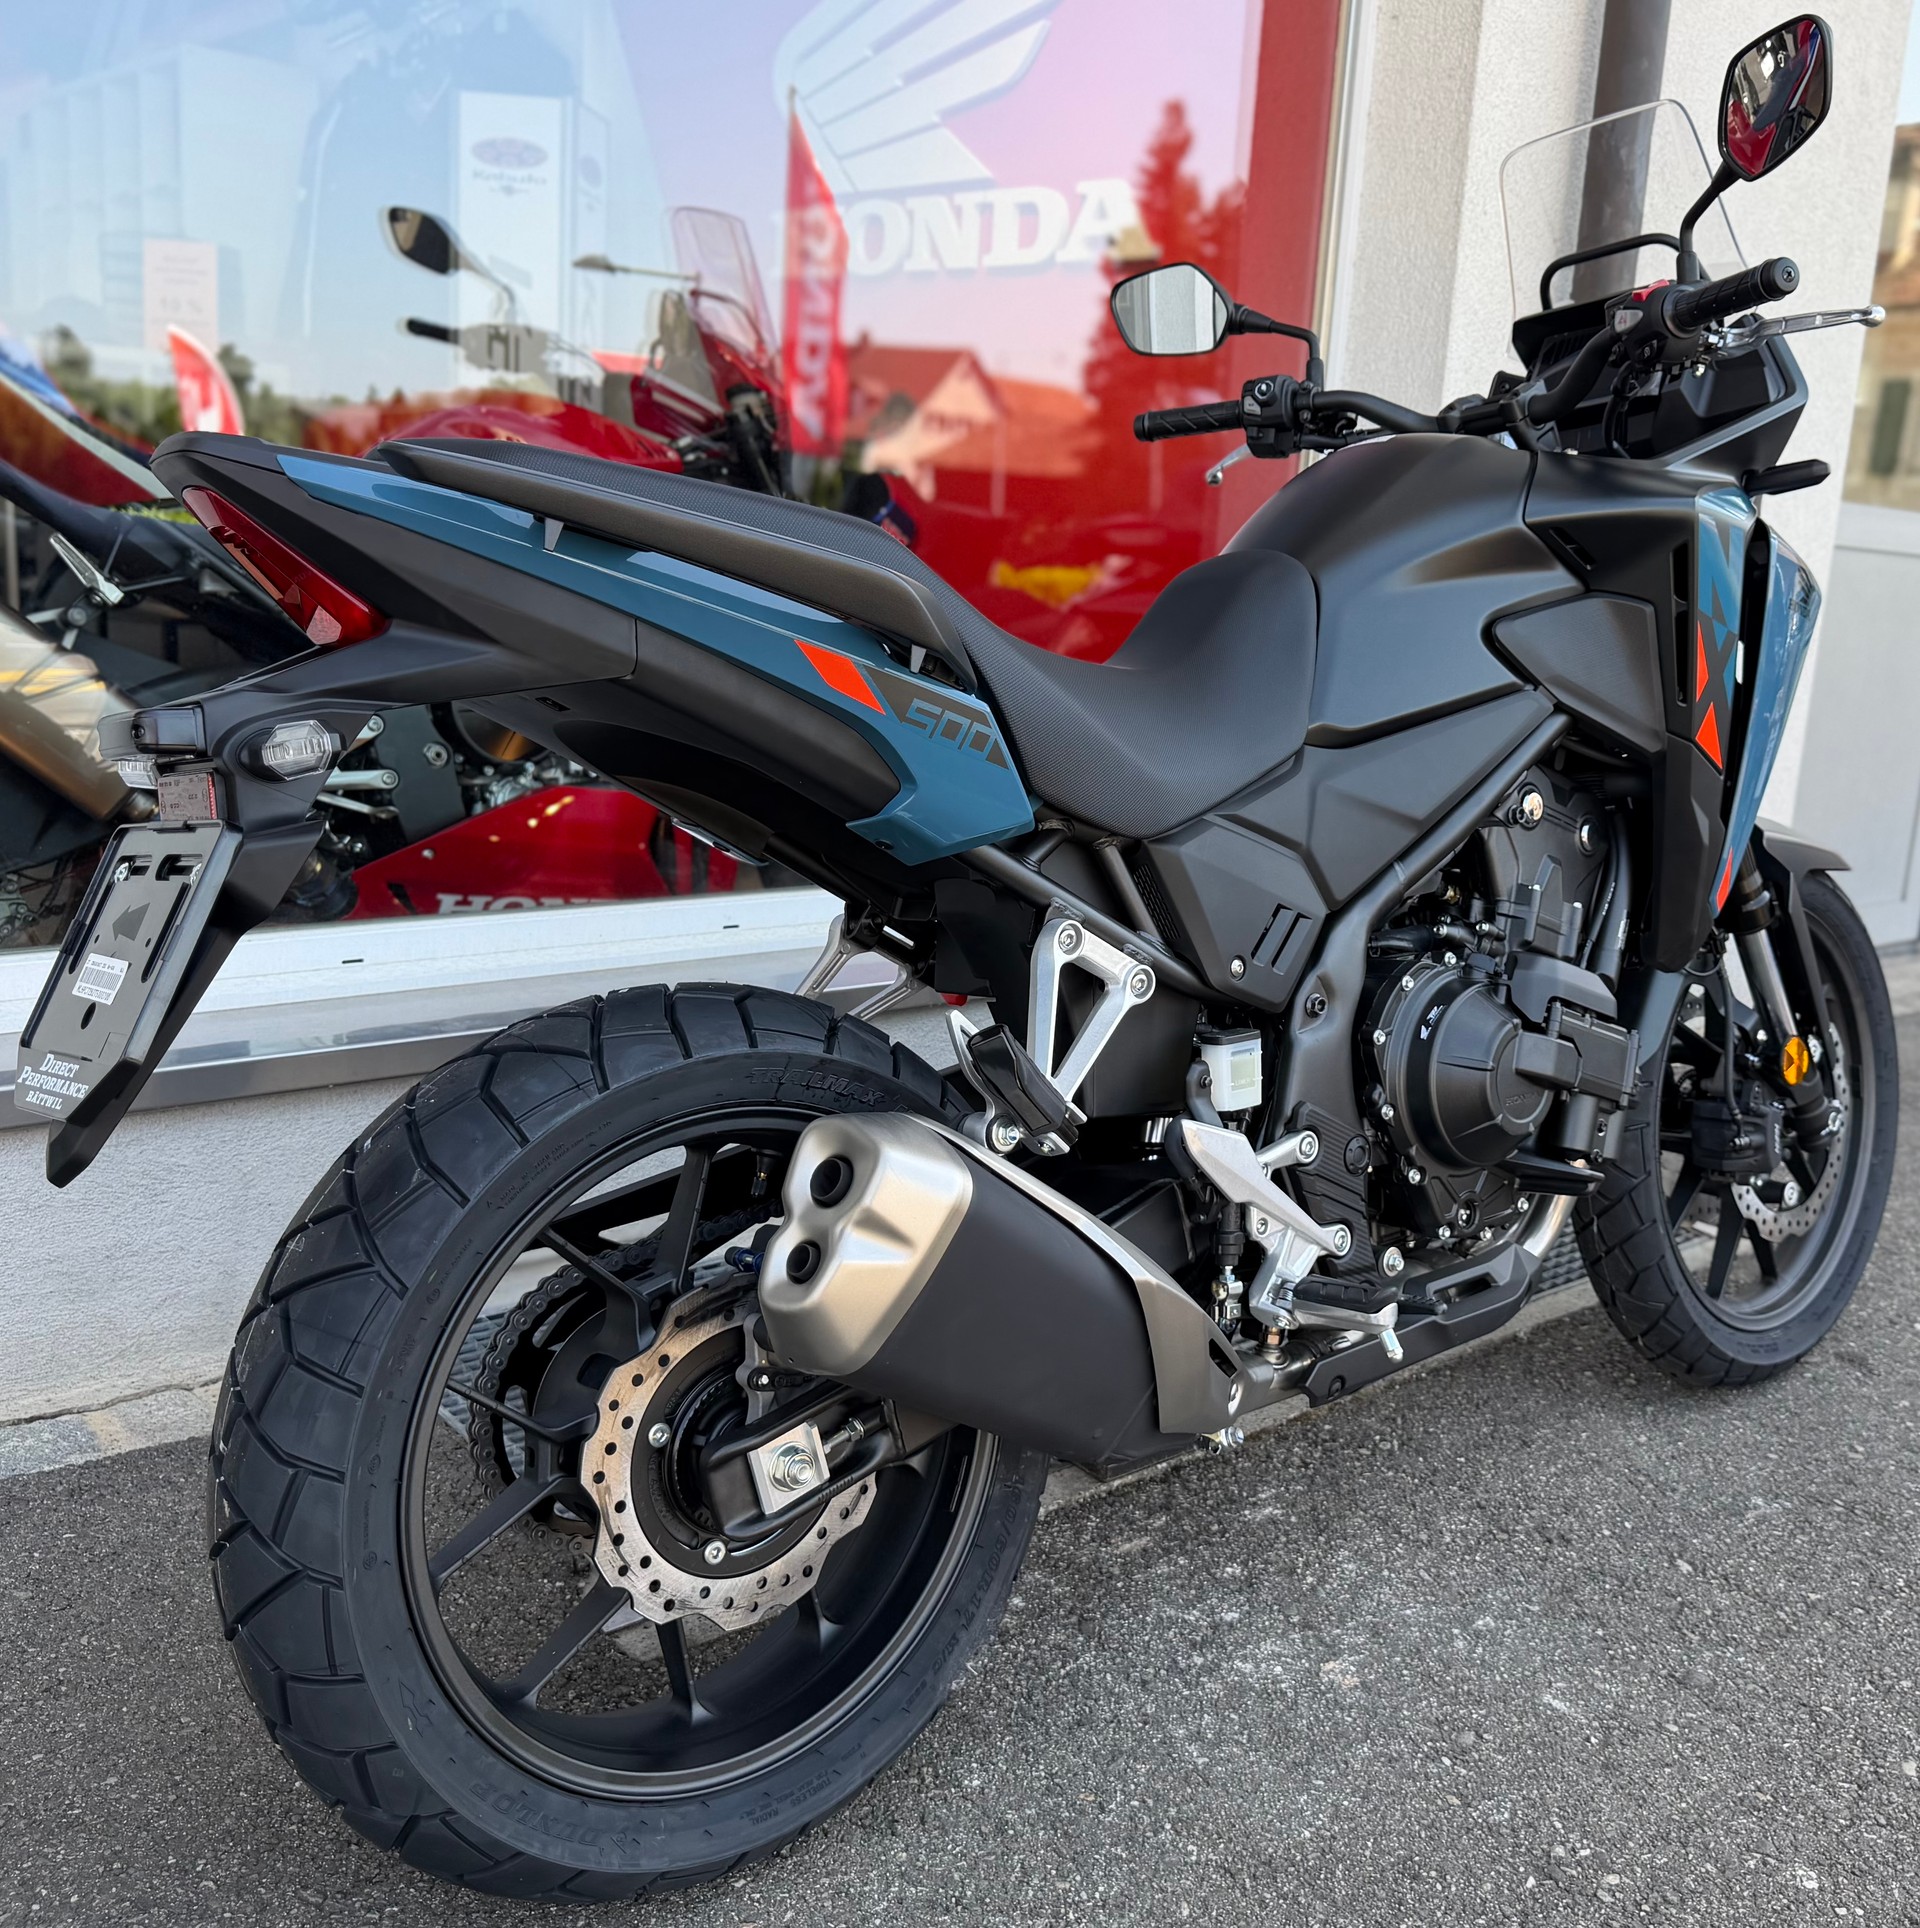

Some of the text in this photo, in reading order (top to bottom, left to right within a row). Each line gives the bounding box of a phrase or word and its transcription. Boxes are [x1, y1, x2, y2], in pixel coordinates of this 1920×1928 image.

[901, 697, 1001, 761] 500
[17, 1065, 89, 1099] PERFORMANCE
[40, 1053, 80, 1078] DIRECT
[25, 1090, 63, 1110] BÄTTWIL
[750, 1066, 887, 1107] TRAILMAX
[469, 1782, 600, 1848] DUNLOP
[748, 1805, 780, 1827] RADIAL
